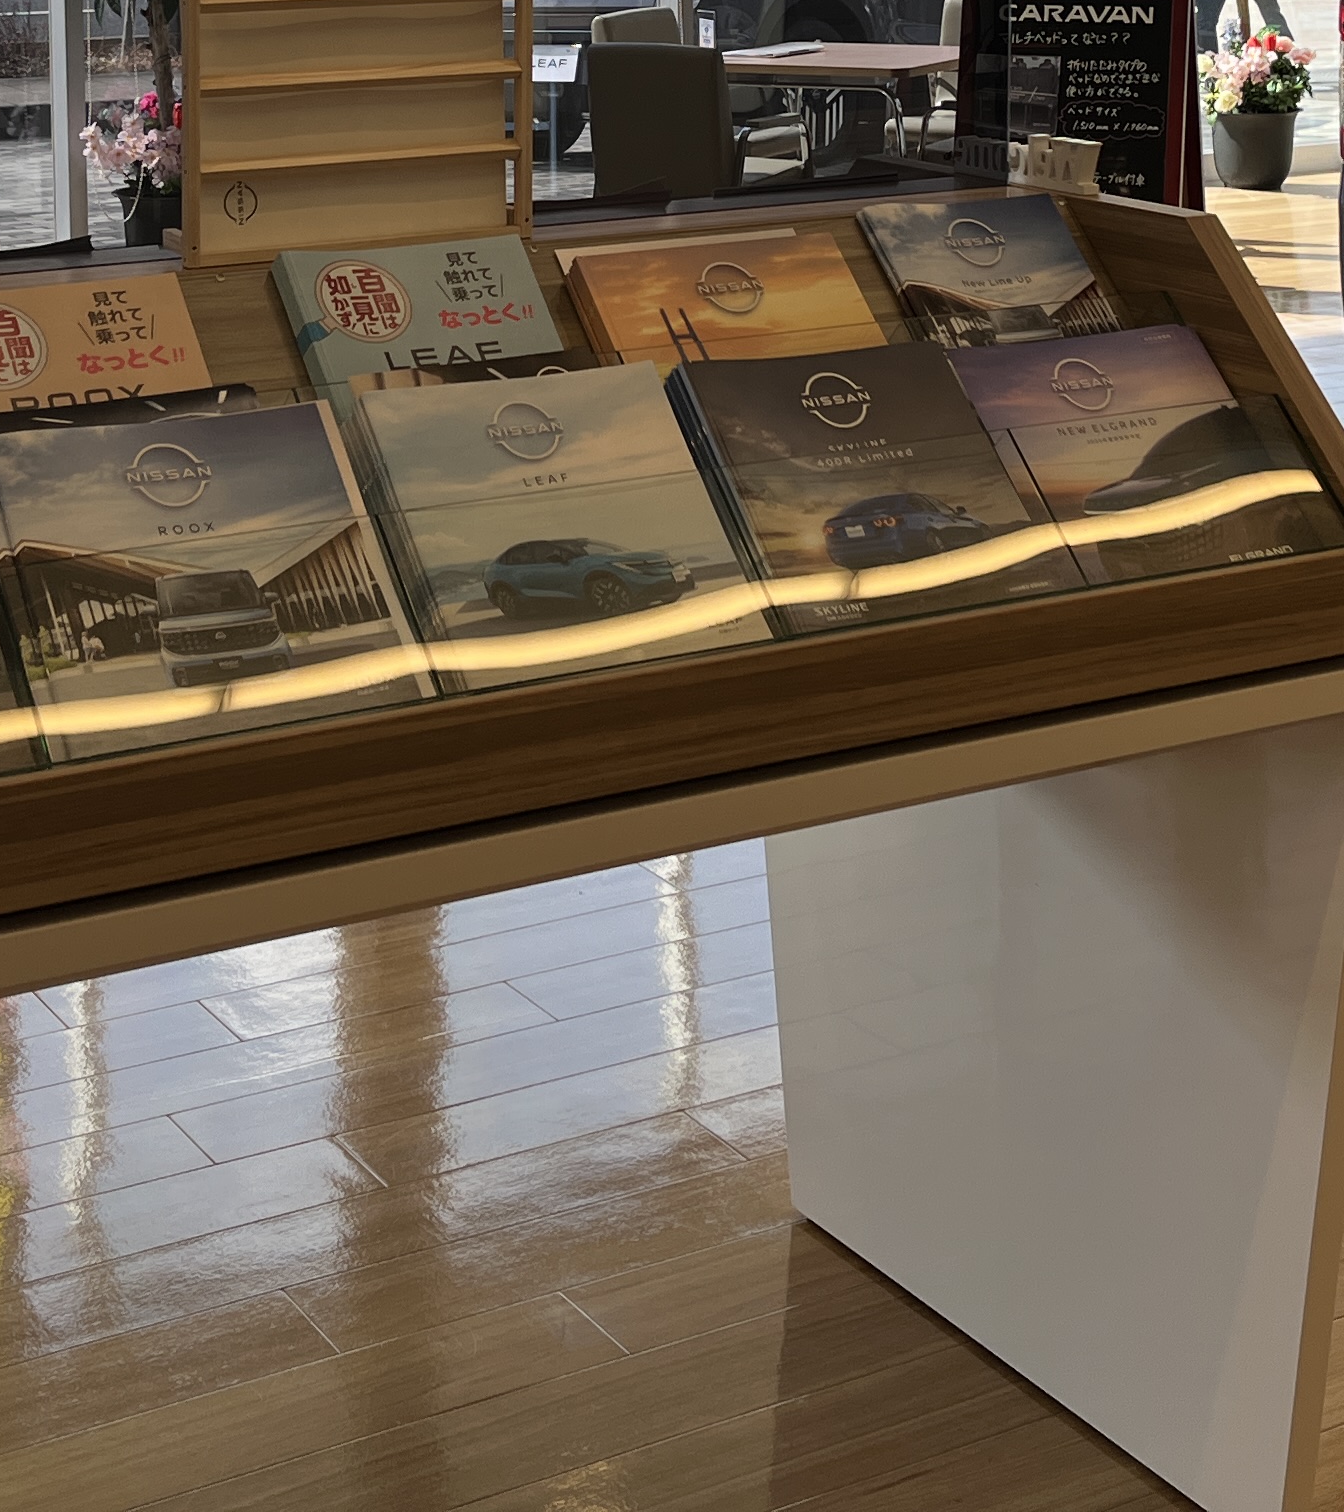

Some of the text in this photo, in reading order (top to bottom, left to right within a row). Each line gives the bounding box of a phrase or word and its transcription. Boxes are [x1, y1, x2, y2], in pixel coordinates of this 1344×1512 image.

[999, 4, 1155, 25] CARAVAN
[532, 58, 569, 69] EAF
[945, 234, 1006, 248] NISSAN
[446, 251, 478, 267] 見て
[443, 267, 493, 285] 触れて
[961, 275, 1033, 288] New Line Up
[452, 284, 498, 302] 乗って
[697, 279, 765, 295] NISSAN
[92, 290, 127, 307] 見て
[87, 307, 144, 327] 触れて
[95, 325, 148, 345] 乗って
[383, 341, 503, 371] LEAF
[1051, 376, 1114, 392] NISSAN
[801, 391, 872, 408] NISSAN
[487, 421, 564, 438] NISSAN
[1056, 417, 1158, 437] NEW ELGRAND
[126, 465, 213, 483] NISSAN
[522, 473, 568, 487] LEAF
[158, 521, 215, 537] ROOX
[813, 601, 870, 617] SKYLINE
